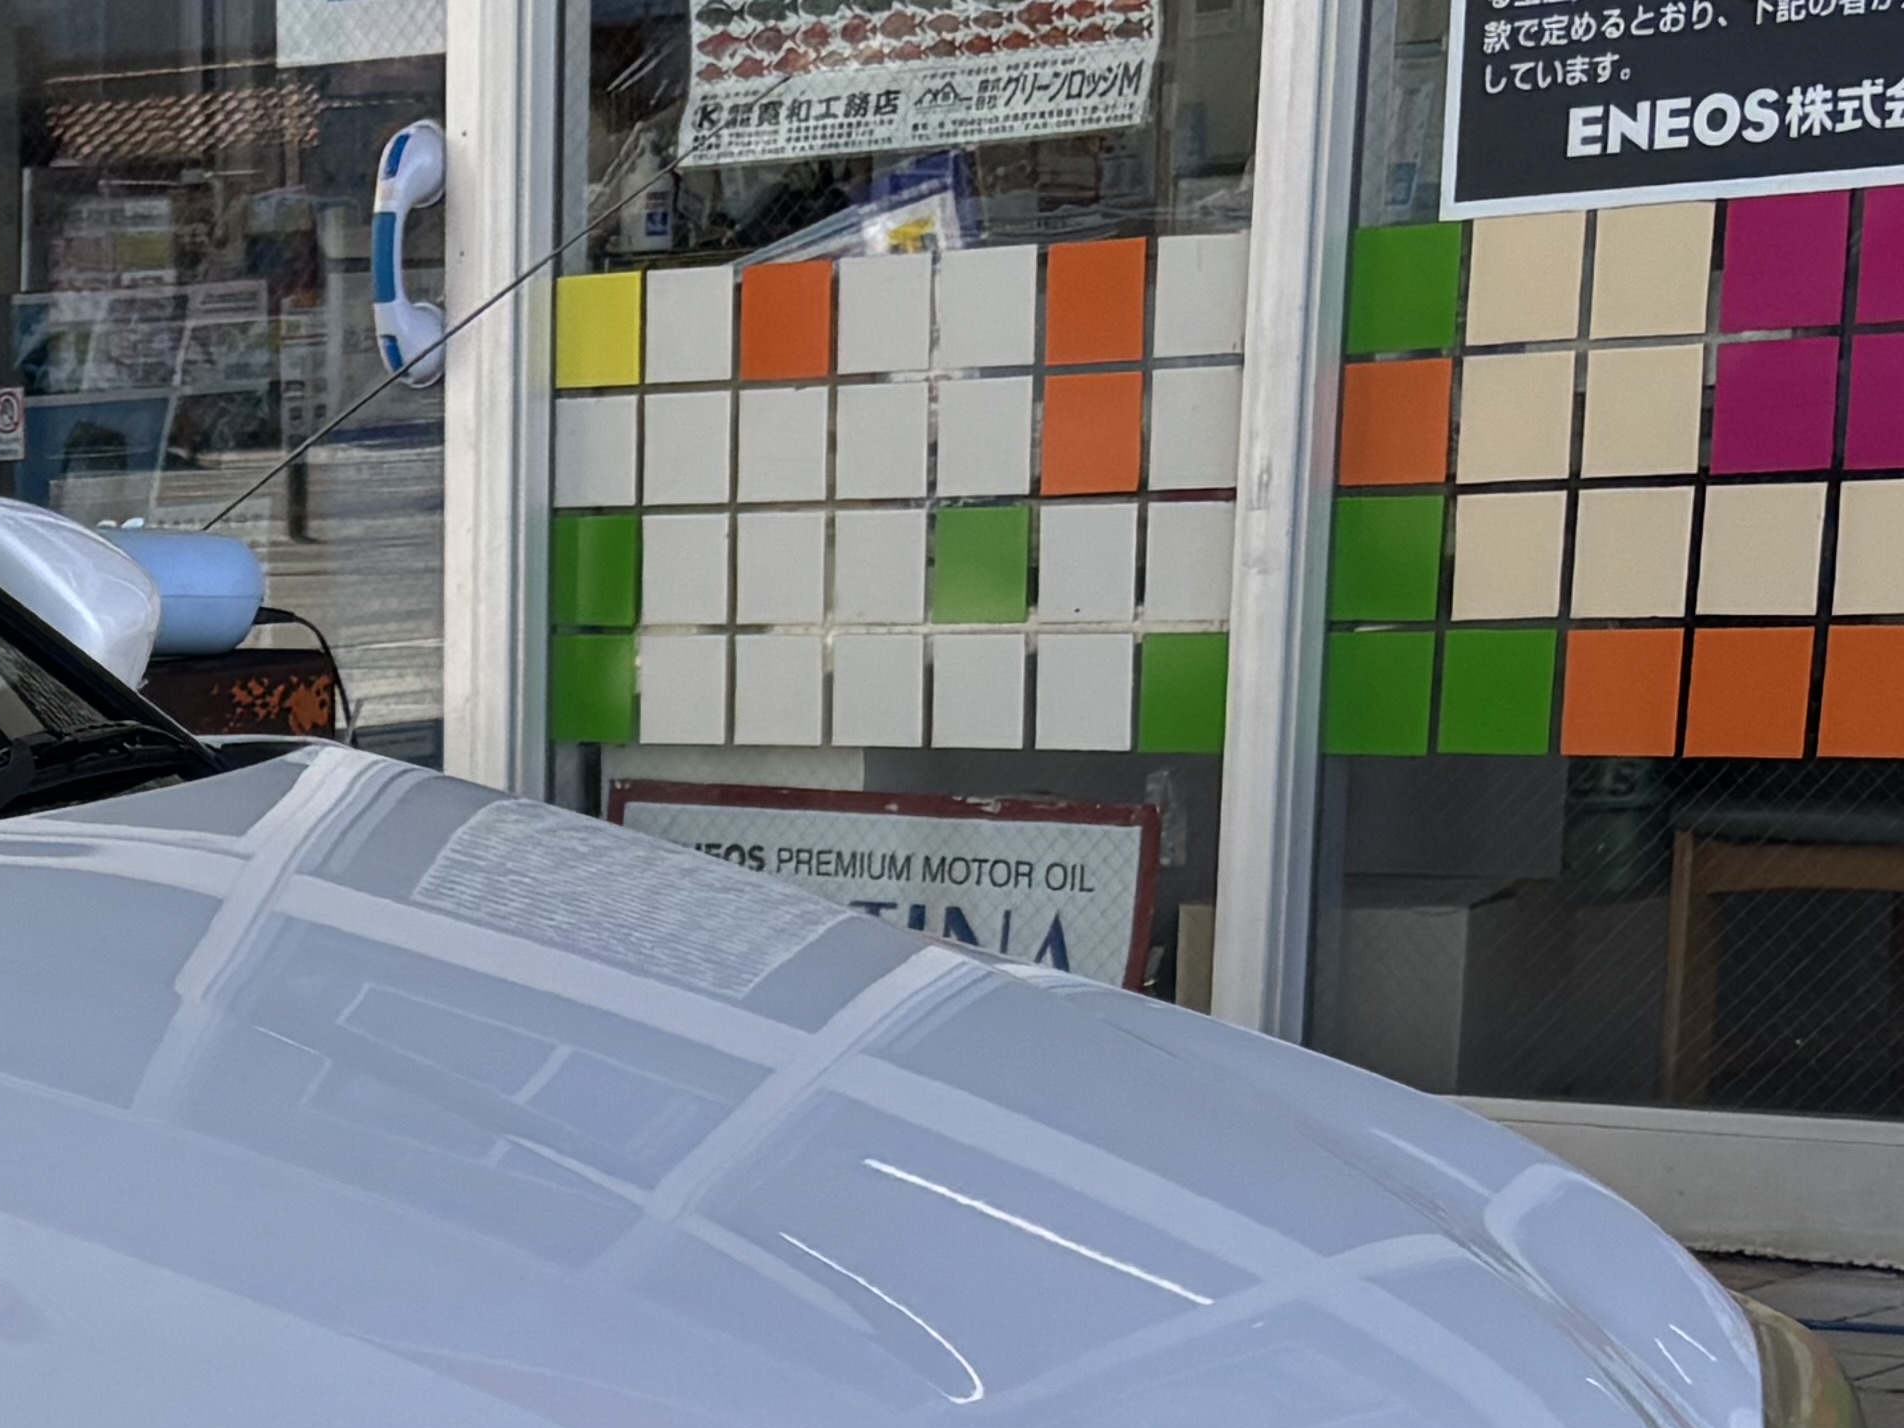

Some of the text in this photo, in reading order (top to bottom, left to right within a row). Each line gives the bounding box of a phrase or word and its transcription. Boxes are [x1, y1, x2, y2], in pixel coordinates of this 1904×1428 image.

[1483, 52, 1632, 94] しています。
[776, 847, 911, 883] PREMIUM
[921, 856, 1033, 889] MOTOR
[1045, 862, 1095, 893] OIL
